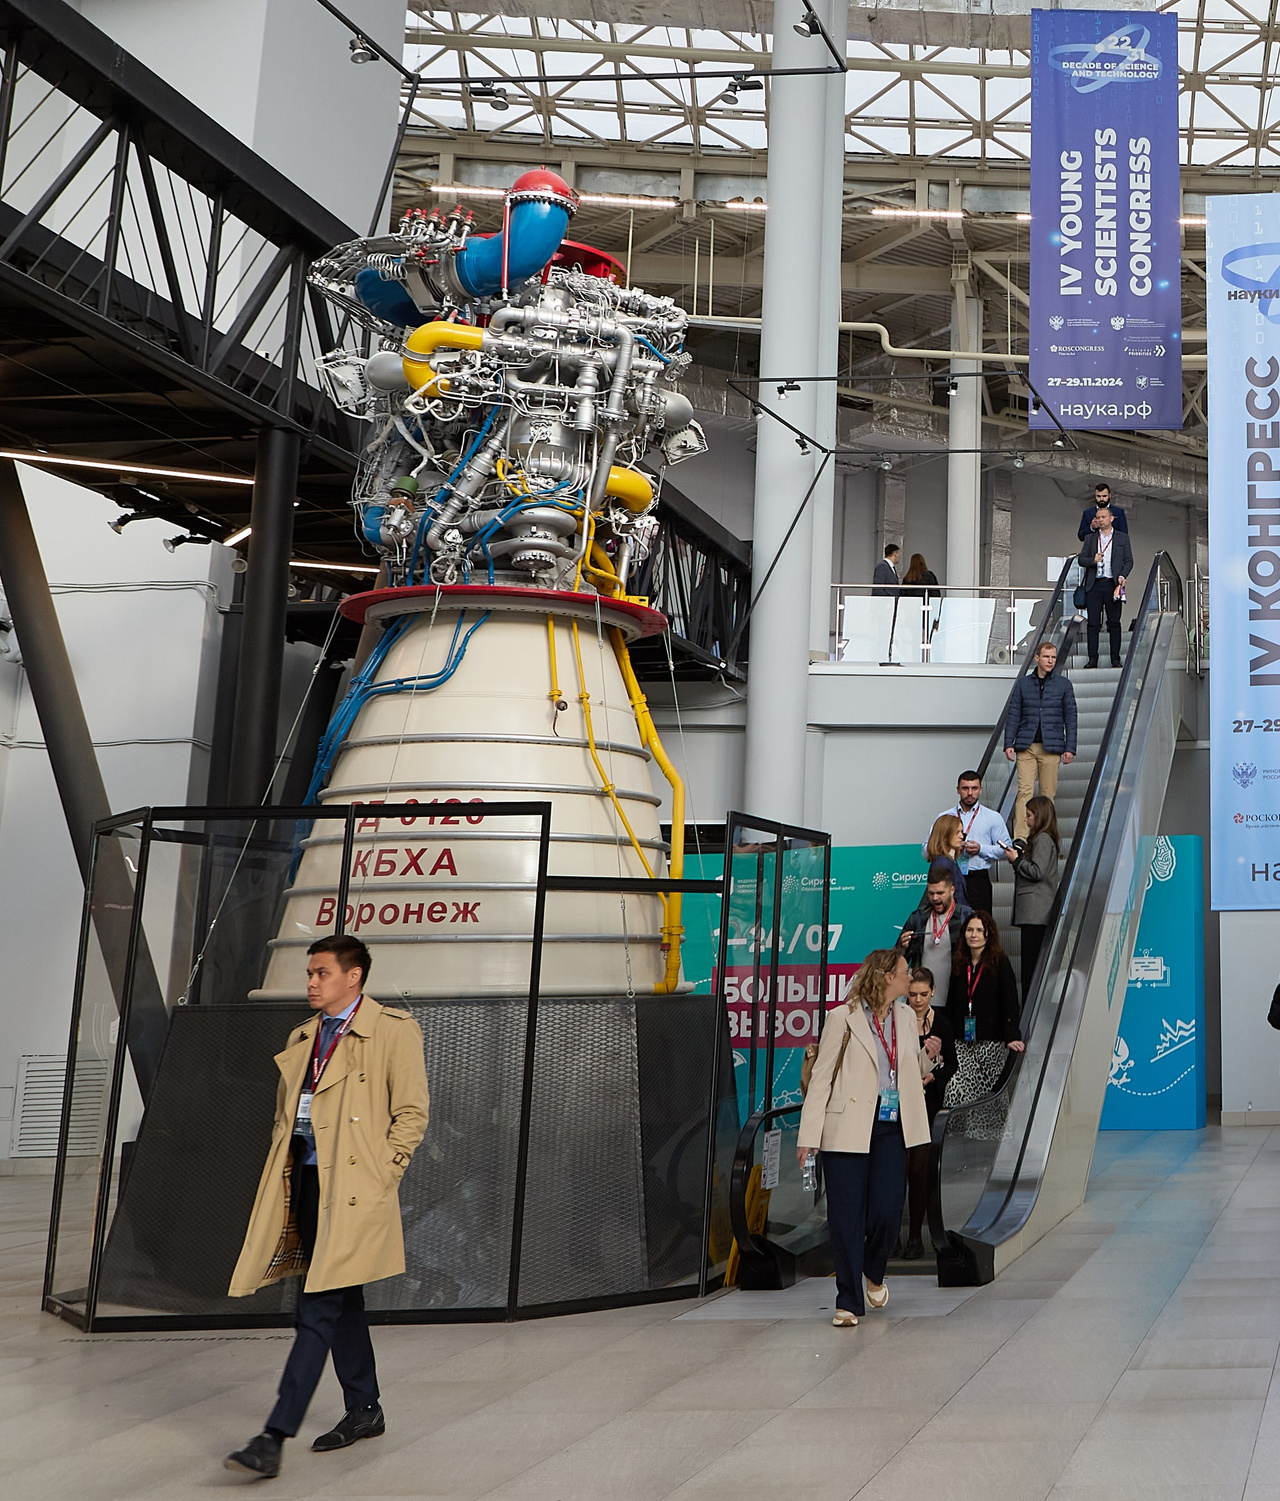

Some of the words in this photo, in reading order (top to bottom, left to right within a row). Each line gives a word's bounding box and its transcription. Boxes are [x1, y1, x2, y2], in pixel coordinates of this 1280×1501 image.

[1108, 36, 1131, 50] 22
[1127, 48, 1145, 60] 31
[1062, 62, 1102, 70] DECADE
[1104, 62, 1117, 70] OF
[1118, 62, 1159, 70] SCIENCE
[1096, 70, 1159, 78] TECHNOLOGY
[1060, 150, 1083, 256] YOUNG
[1094, 128, 1118, 297] SCIENTISTS
[1129, 137, 1152, 296] CONGRESS
[1060, 264, 1082, 296] IV
[1227, 288, 1280, 304] науки
[1060, 401, 1152, 419] наука.рф
[351, 848, 458, 878] КБХА
[801, 877, 837, 886] Сирис
[892, 872, 928, 883] Сириус
[724, 974, 858, 1004] БОЛЬШИ
[728, 1009, 828, 1038] ВЫЗО
